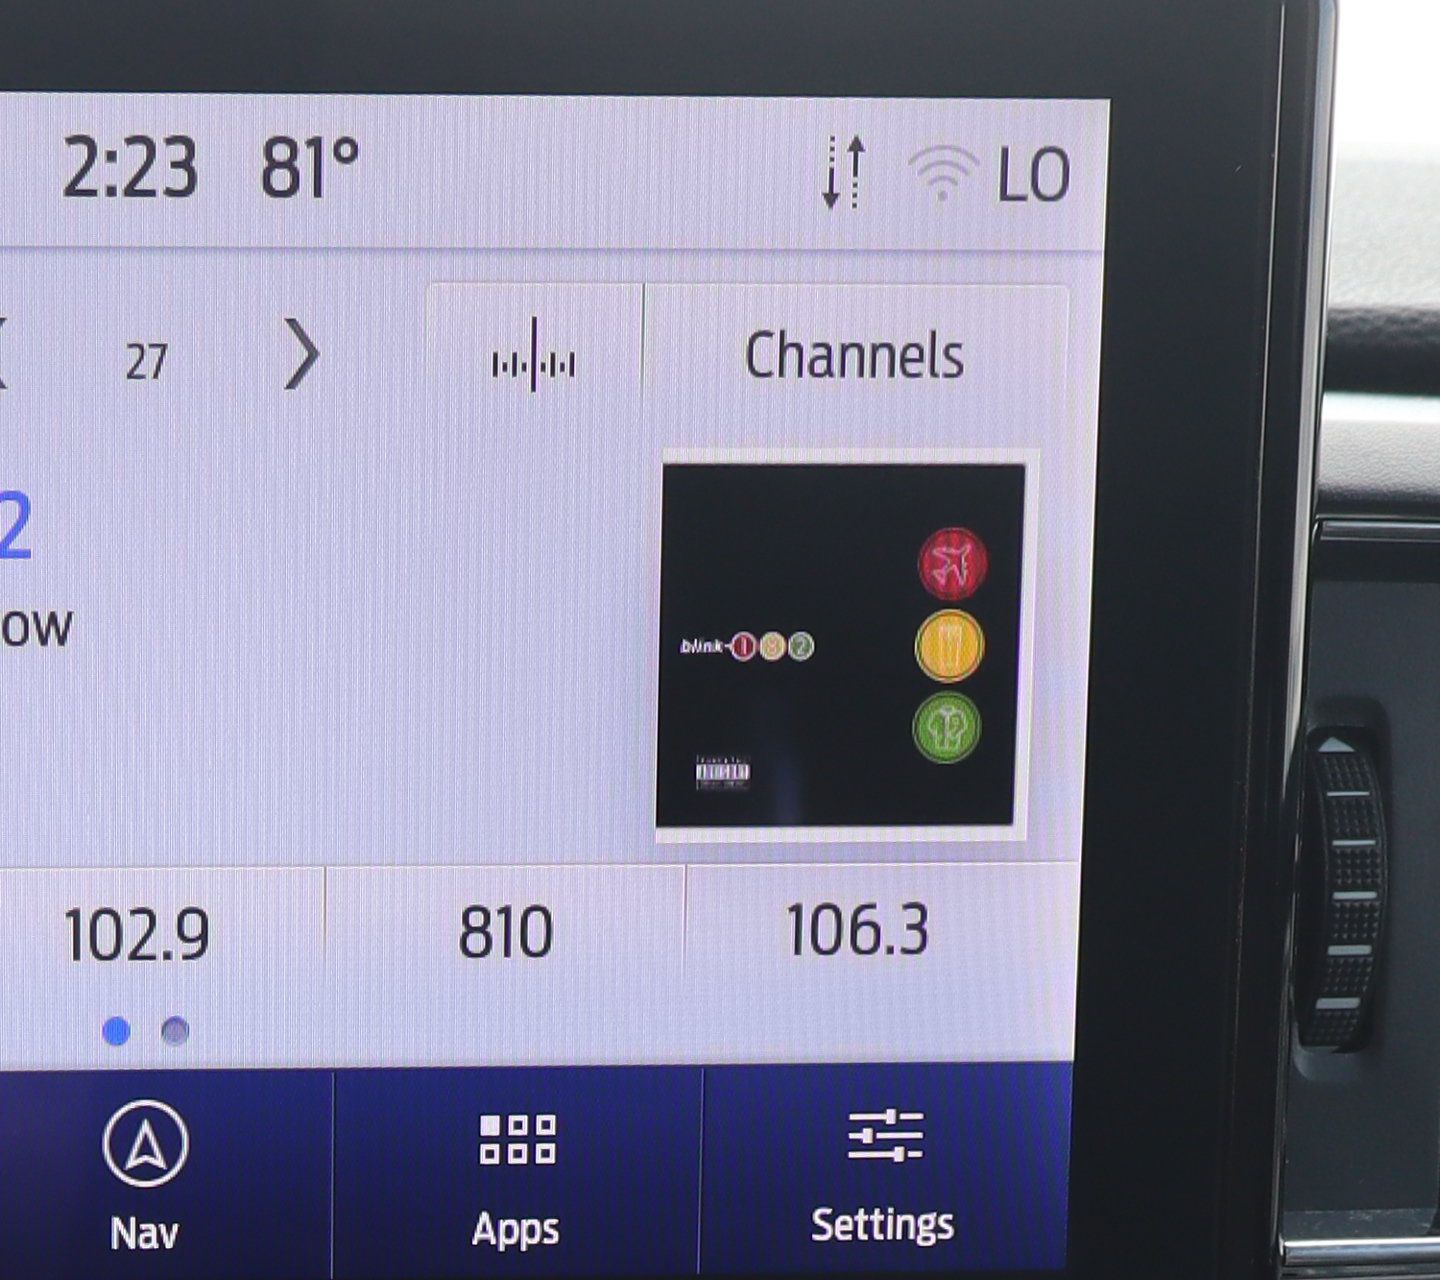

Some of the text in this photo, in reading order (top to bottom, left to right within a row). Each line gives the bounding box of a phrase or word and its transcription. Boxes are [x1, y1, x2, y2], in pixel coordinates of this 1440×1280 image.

[62, 134, 360, 200] 2:23 81°
[999, 146, 1071, 204] LO
[126, 343, 169, 381] 27
[746, 329, 965, 380] Channels
[63, 906, 211, 962] 102.9
[459, 904, 553, 960] 810
[787, 902, 930, 957] 106.3
[110, 1216, 180, 1251] Nav
[472, 1211, 560, 1250] Apps
[811, 1206, 955, 1245] Settings
